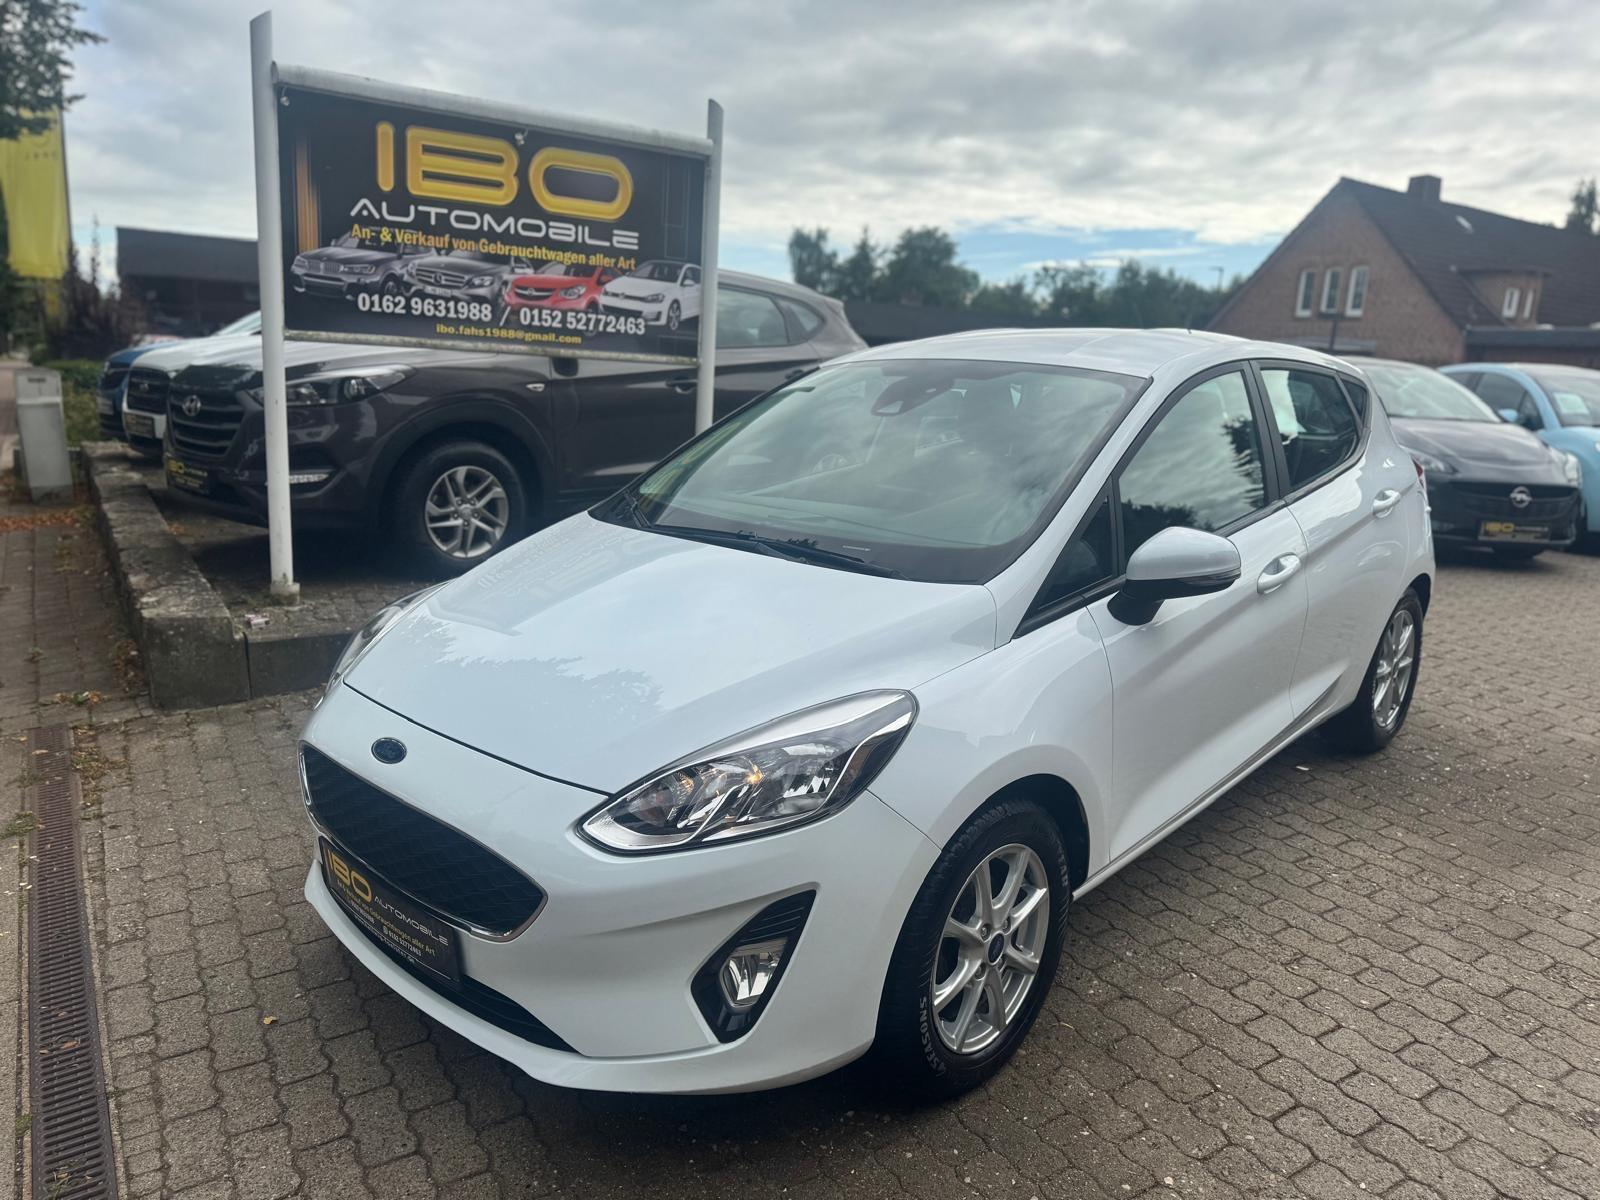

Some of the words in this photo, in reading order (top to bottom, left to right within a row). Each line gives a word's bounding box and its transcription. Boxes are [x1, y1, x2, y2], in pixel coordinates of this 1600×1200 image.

[376, 122, 633, 221] IBO
[350, 198, 639, 250] AUTOMOBILE
[351, 223, 376, 239] An-
[380, 227, 392, 242] &
[395, 229, 450, 249] Verkauf
[452, 238, 476, 251] von
[479, 239, 586, 265] Gebrauchtwagen
[588, 253, 616, 268] aller
[617, 257, 637, 270] Art
[357, 293, 406, 314] 0162
[410, 297, 492, 322] 9631988
[519, 307, 563, 328] 0152
[566, 311, 646, 335] 52772463
[327, 849, 372, 902] IBO
[374, 896, 449, 946] AUTOMOBILE
